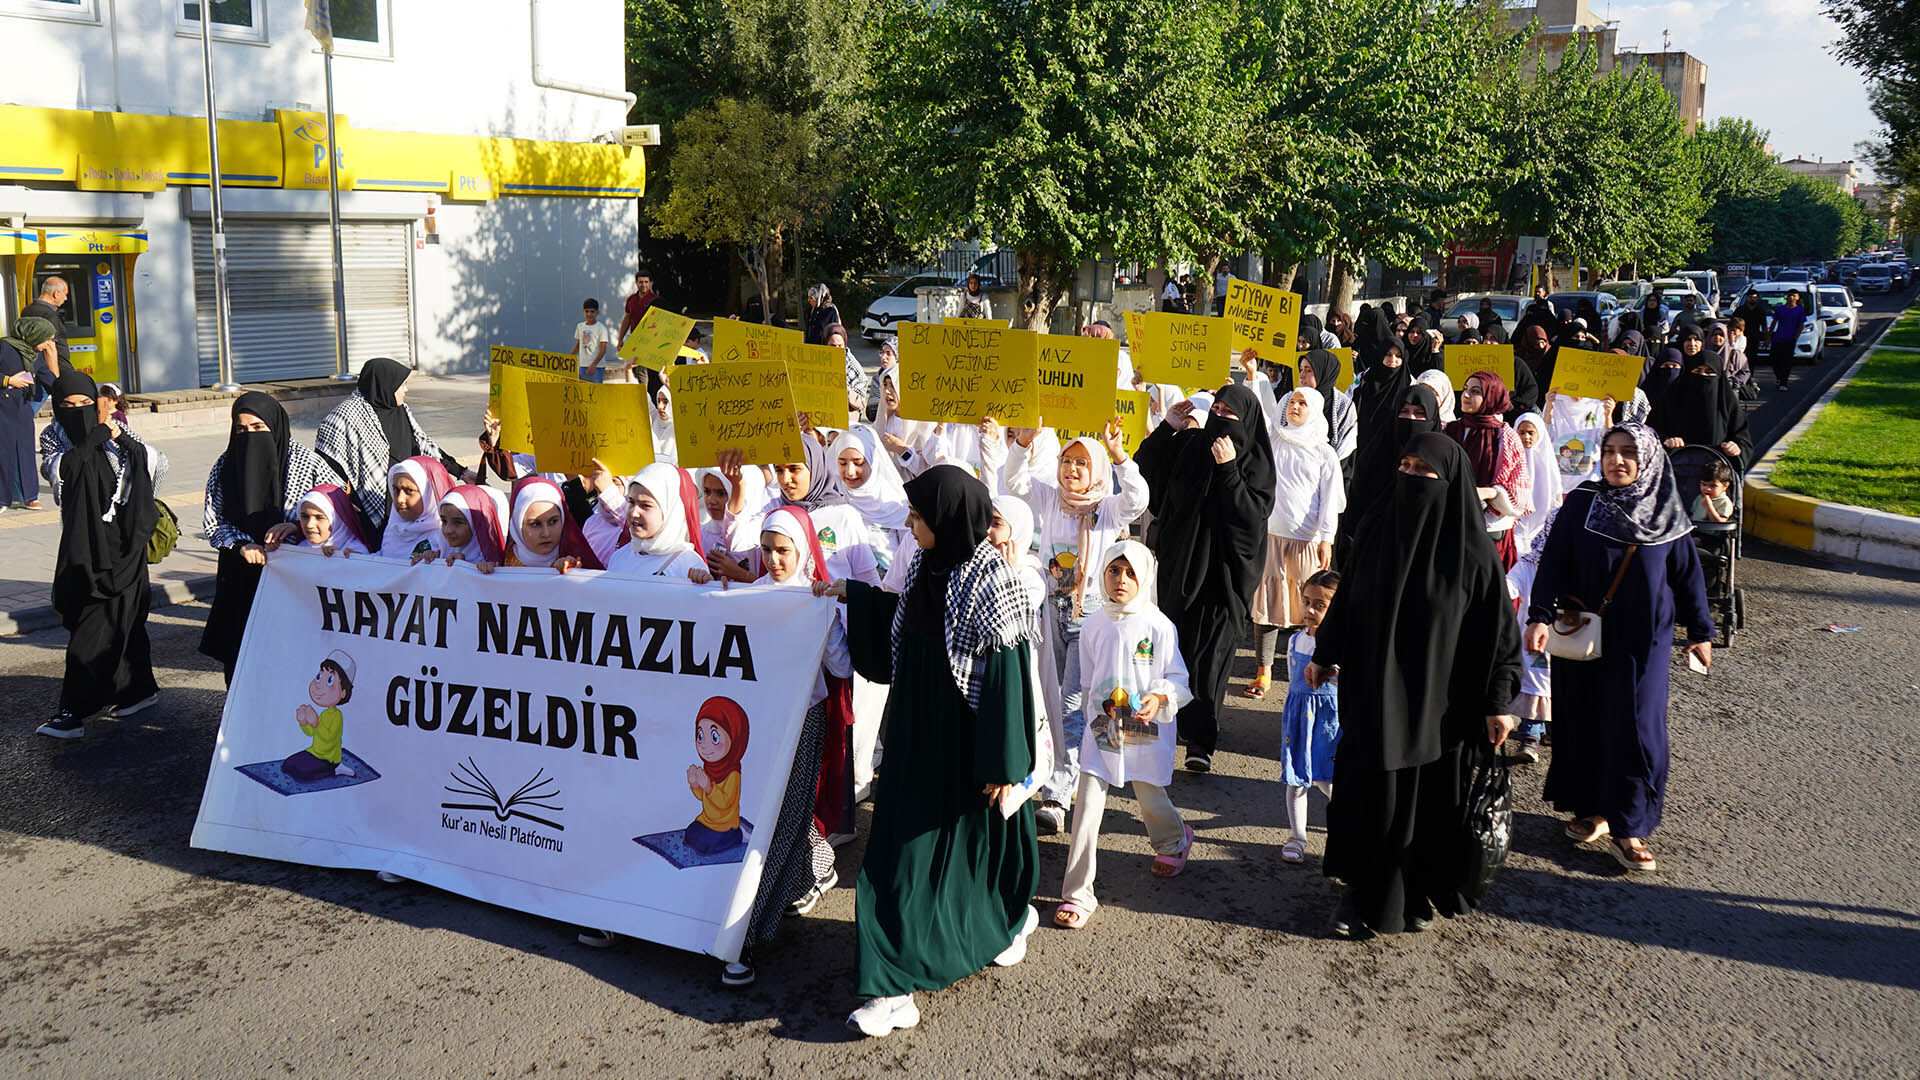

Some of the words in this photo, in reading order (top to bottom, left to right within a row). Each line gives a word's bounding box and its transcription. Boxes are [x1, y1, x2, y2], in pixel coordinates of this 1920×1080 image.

[314, 144, 344, 168] Pt
[317, 586, 458, 648] HAYAT
[476, 601, 758, 681] NAMAZLA
[386, 665, 639, 760] GÜZELDİR
[441, 813, 477, 834] Kur'an
[479, 820, 507, 840] Nesli
[509, 826, 563, 852] Platformu
